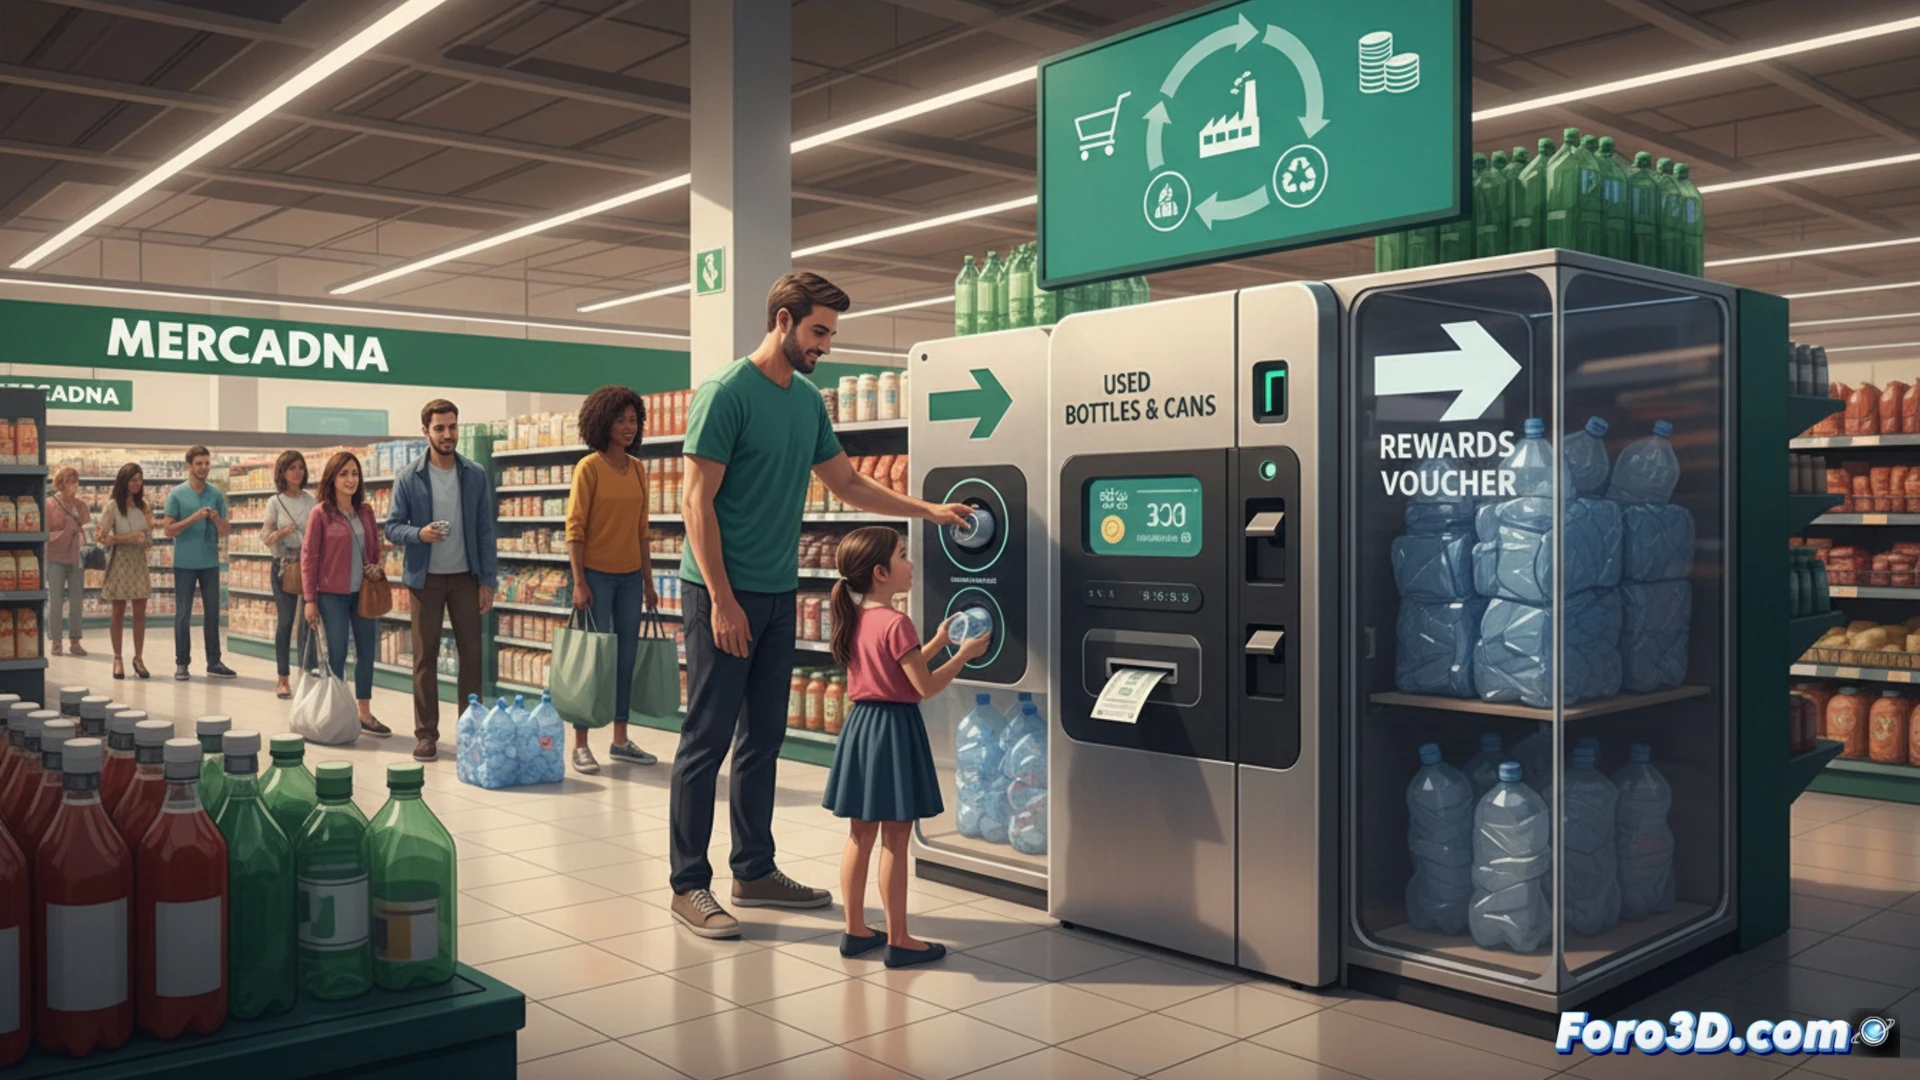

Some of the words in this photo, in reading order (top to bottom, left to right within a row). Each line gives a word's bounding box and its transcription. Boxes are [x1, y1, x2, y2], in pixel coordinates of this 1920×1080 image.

[107, 317, 389, 373] MERCADNA
[1103, 371, 1151, 395] USED
[1065, 399, 1141, 425] BOTTLES
[1145, 398, 1159, 420] &
[1164, 394, 1216, 419] CANS
[1380, 430, 1516, 460] REWARDS
[1380, 469, 1517, 497] VOUCHER
